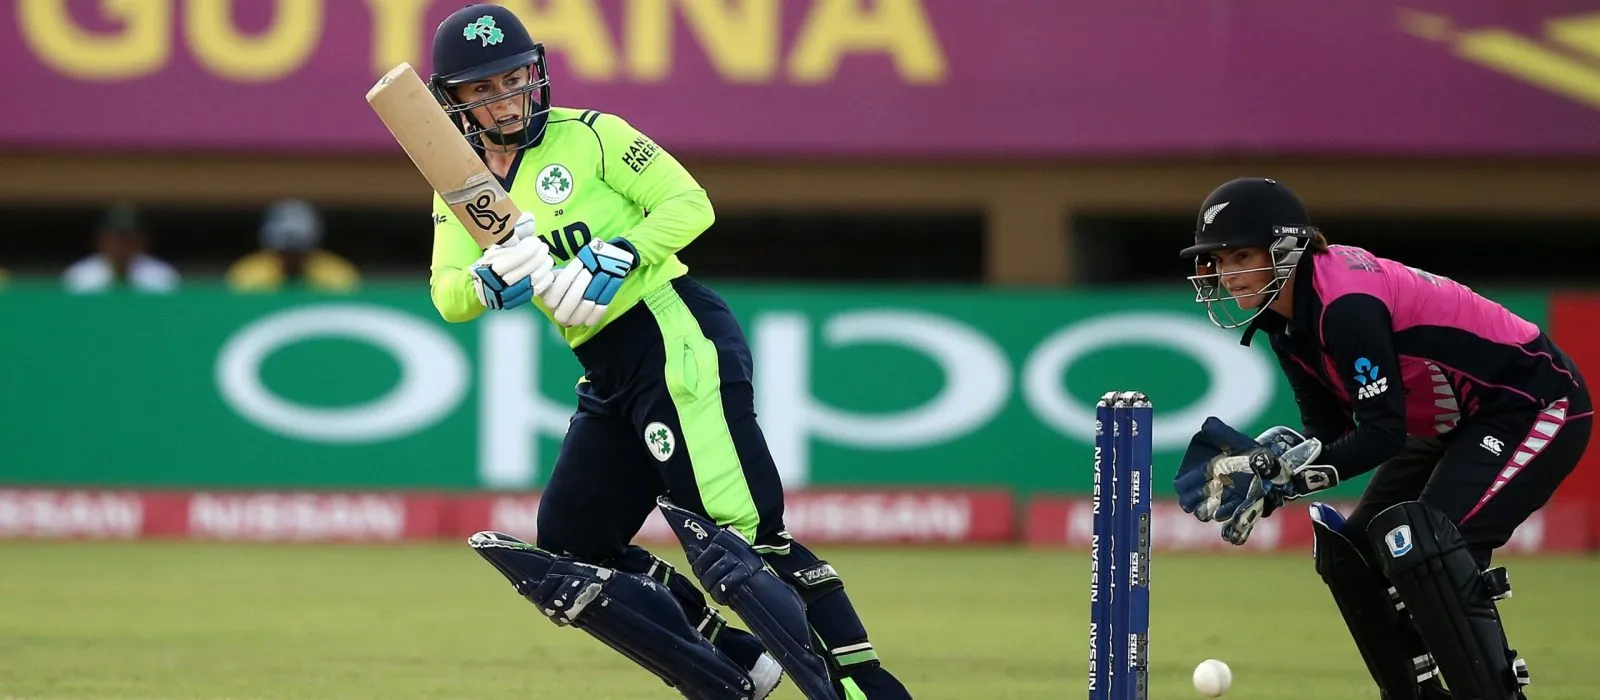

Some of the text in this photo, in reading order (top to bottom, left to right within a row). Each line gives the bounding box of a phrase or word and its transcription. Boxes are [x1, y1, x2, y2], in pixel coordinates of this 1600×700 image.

[554, 209, 564, 217] 20
[1281, 226, 1299, 234] SHREY
[1358, 376, 1388, 400] ANZ
[1093, 446, 1101, 515] NISSAN
[1132, 470, 1140, 505] TYRES
[188, 491, 405, 538] NISSAN
[1091, 534, 1100, 603] NISSAN
[1131, 551, 1139, 586] TYRES
[1088, 622, 1097, 691] NISSAN
[1129, 633, 1137, 668] TYRES
